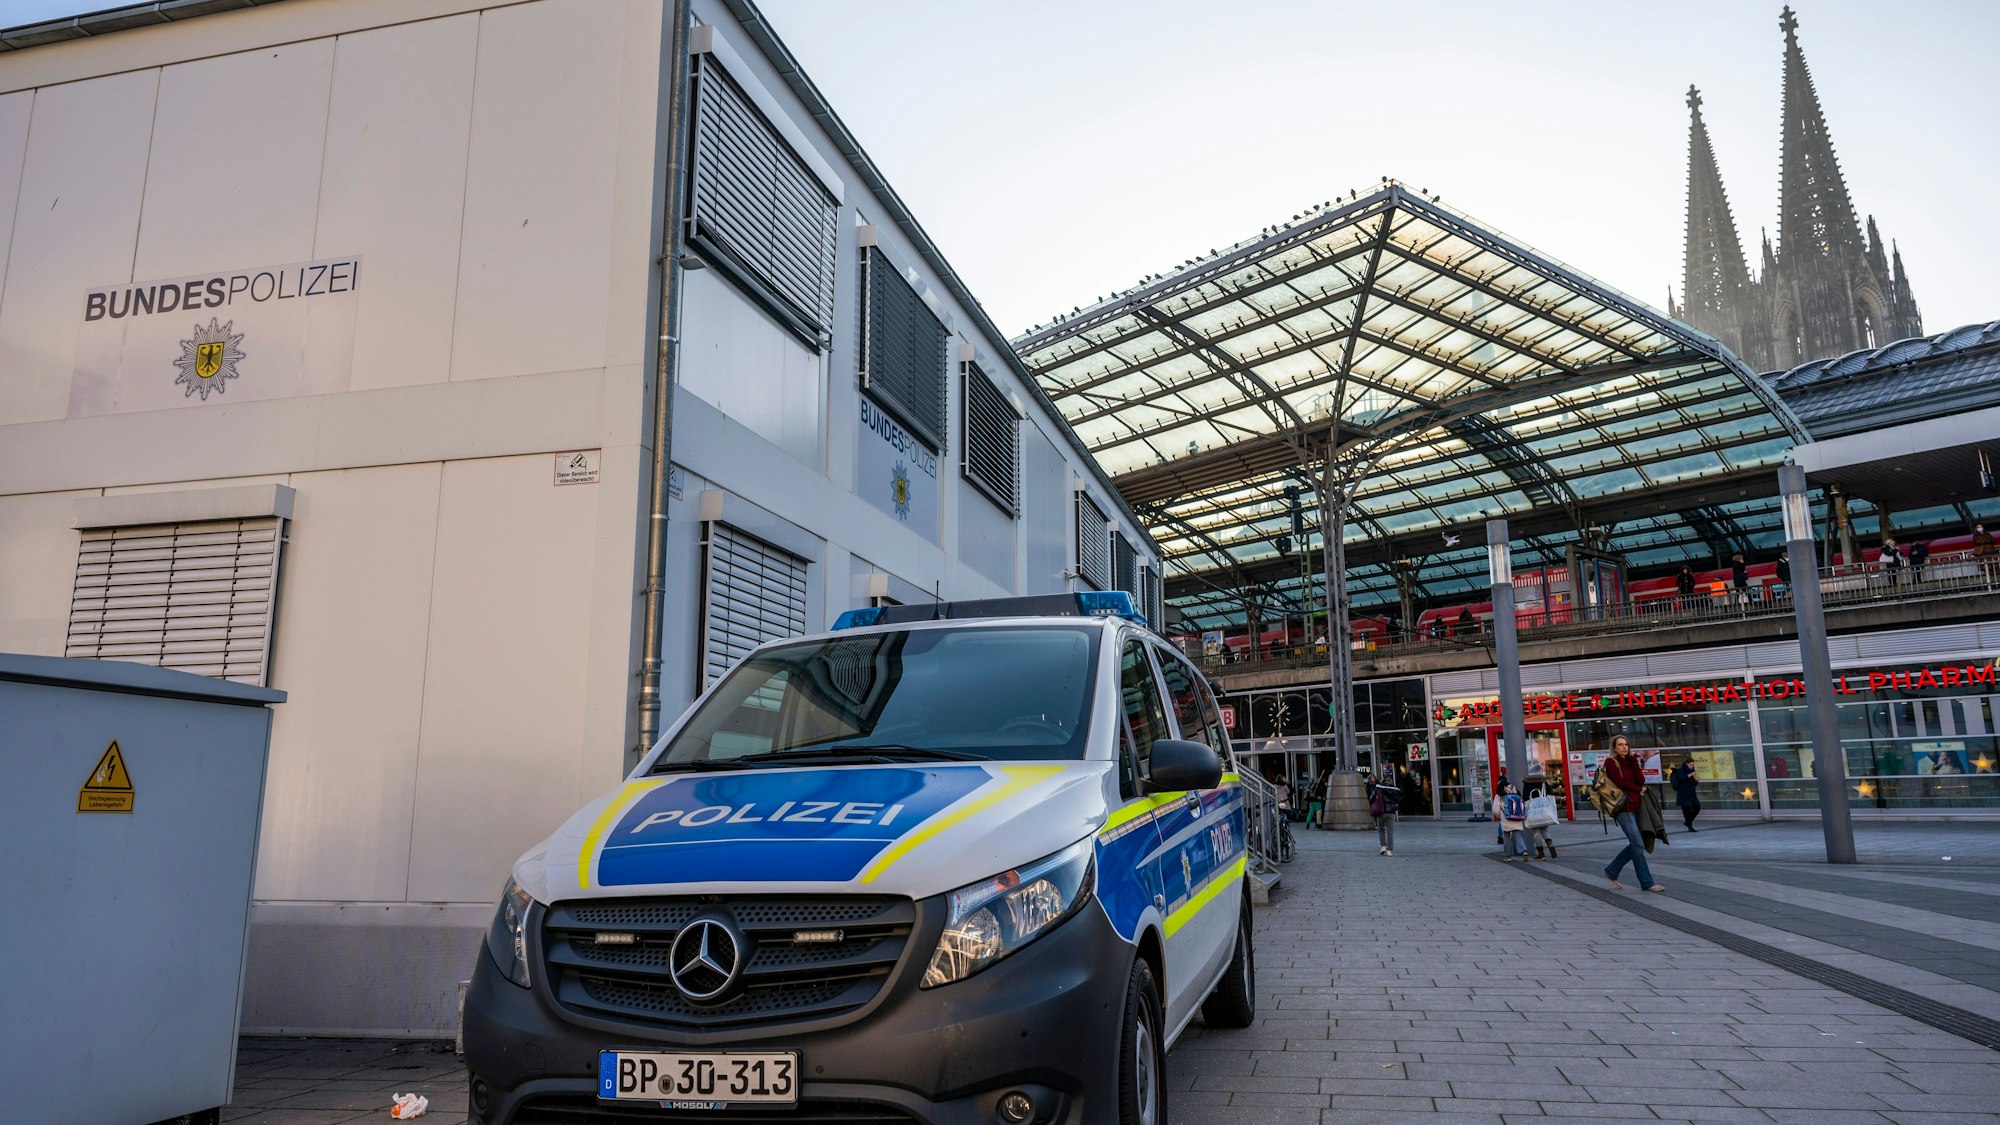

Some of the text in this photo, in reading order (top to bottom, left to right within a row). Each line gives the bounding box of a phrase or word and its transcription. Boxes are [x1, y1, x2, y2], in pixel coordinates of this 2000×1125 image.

[85, 261, 358, 322] BUNDESPOLIZEI
[861, 398, 937, 480] BUNDESPOLIZEI
[1459, 664, 1996, 719] APOHEKE INTERNATIONL PHARM
[630, 801, 904, 834] POLIZEI
[1210, 822, 1233, 866] POLIZEI
[605, 1079, 612, 1090] D
[676, 1060, 792, 1096] 30-313
[672, 1102, 717, 1110] MOSOLF
